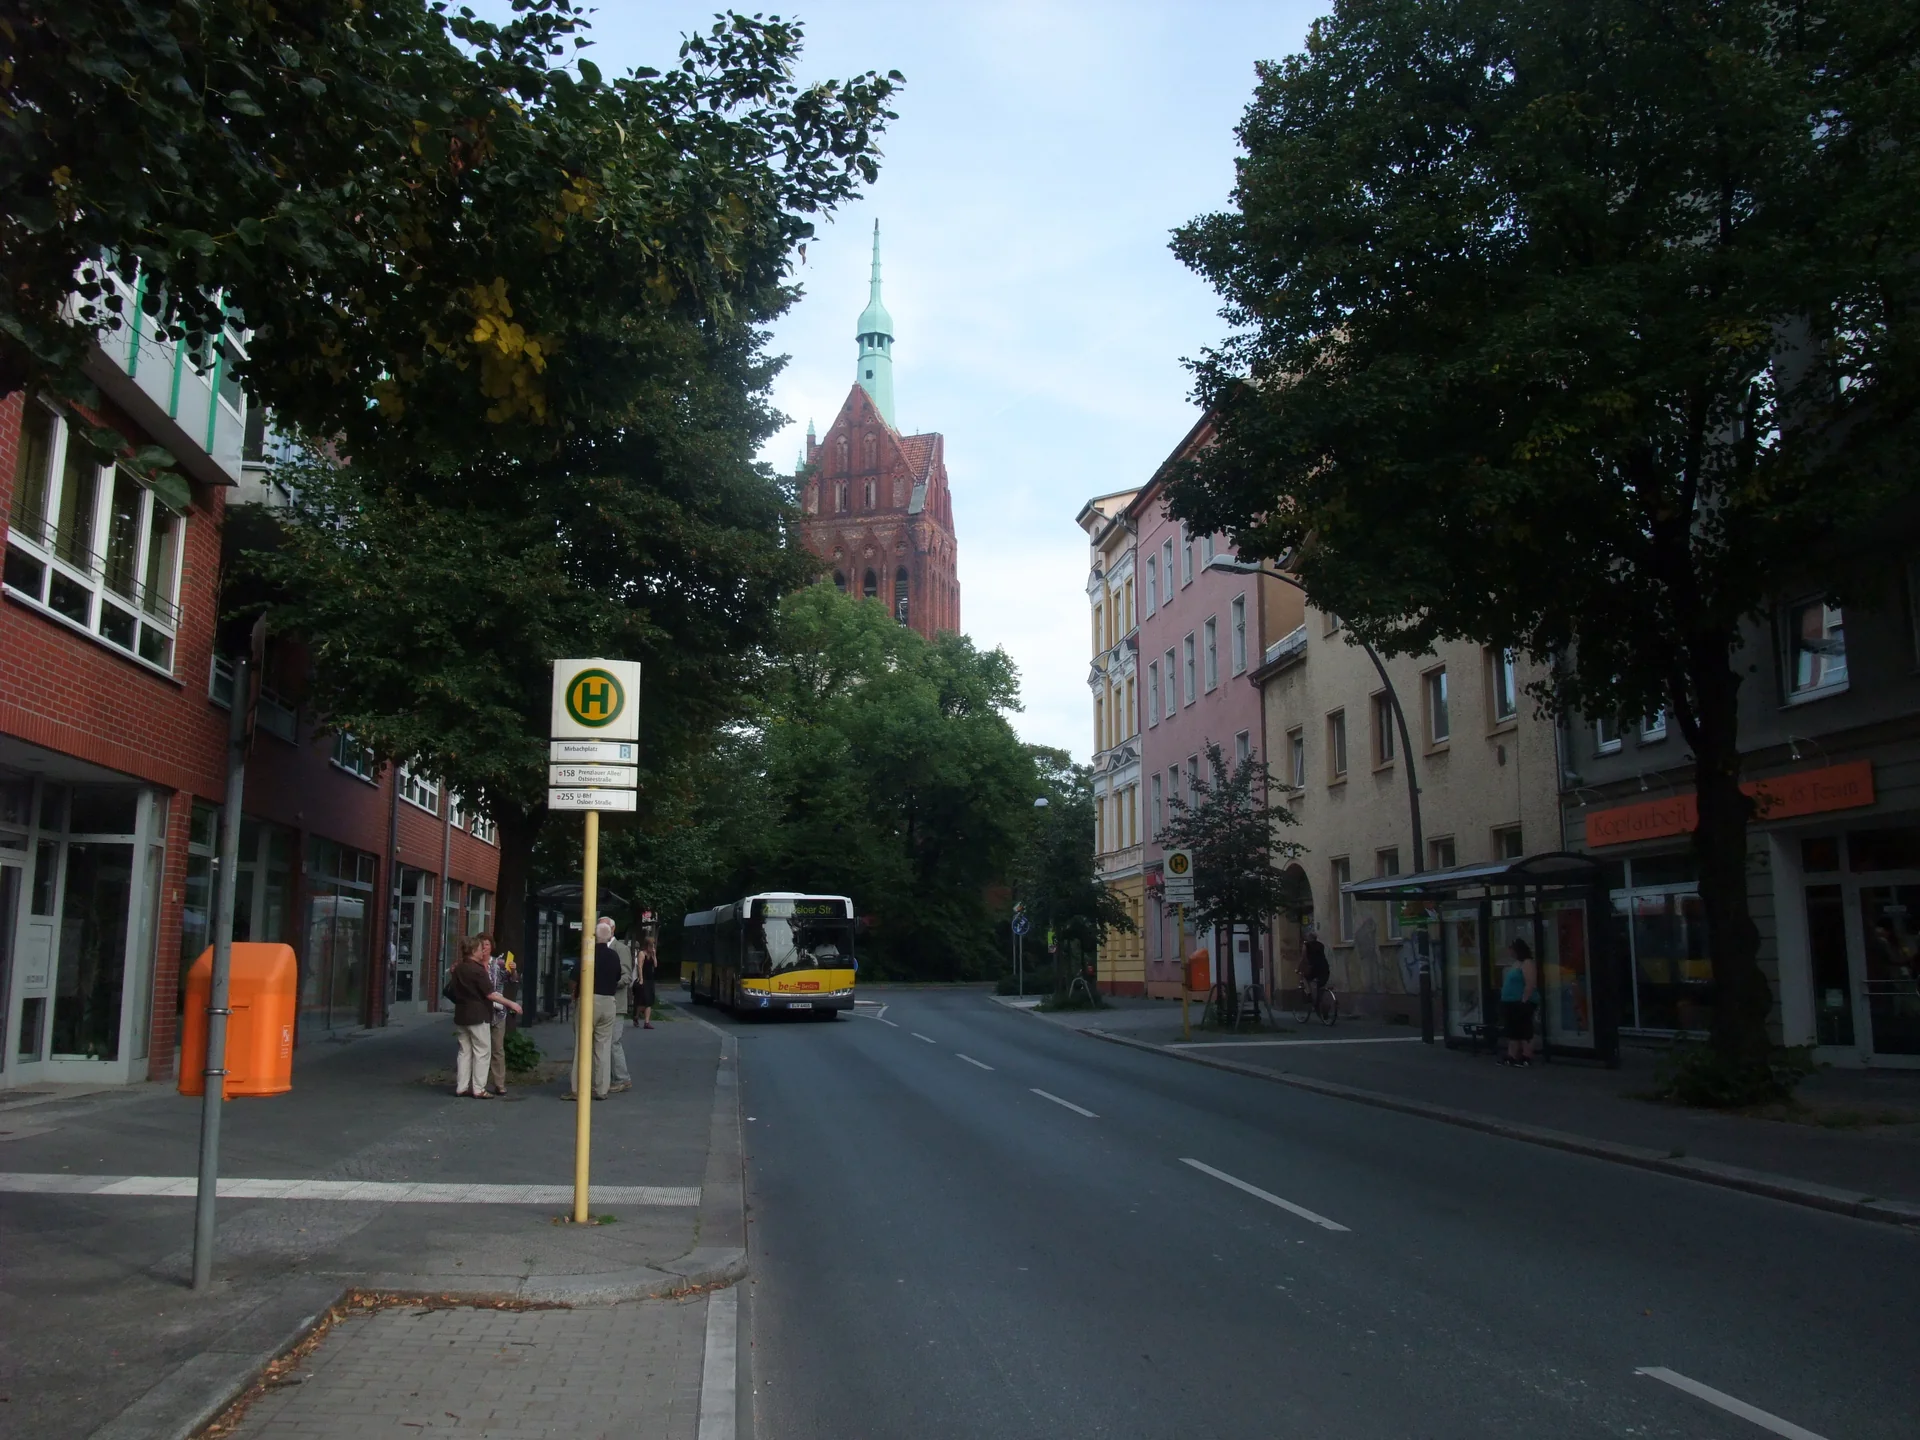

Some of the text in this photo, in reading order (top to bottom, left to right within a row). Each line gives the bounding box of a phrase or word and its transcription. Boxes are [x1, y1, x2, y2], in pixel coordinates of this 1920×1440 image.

[581, 682, 610, 714] H
[563, 769, 575, 777] 158
[561, 793, 574, 801] 255
[1593, 803, 1691, 837] Kopfarbeit
[1812, 781, 1859, 803] Team
[778, 981, 789, 990] be
